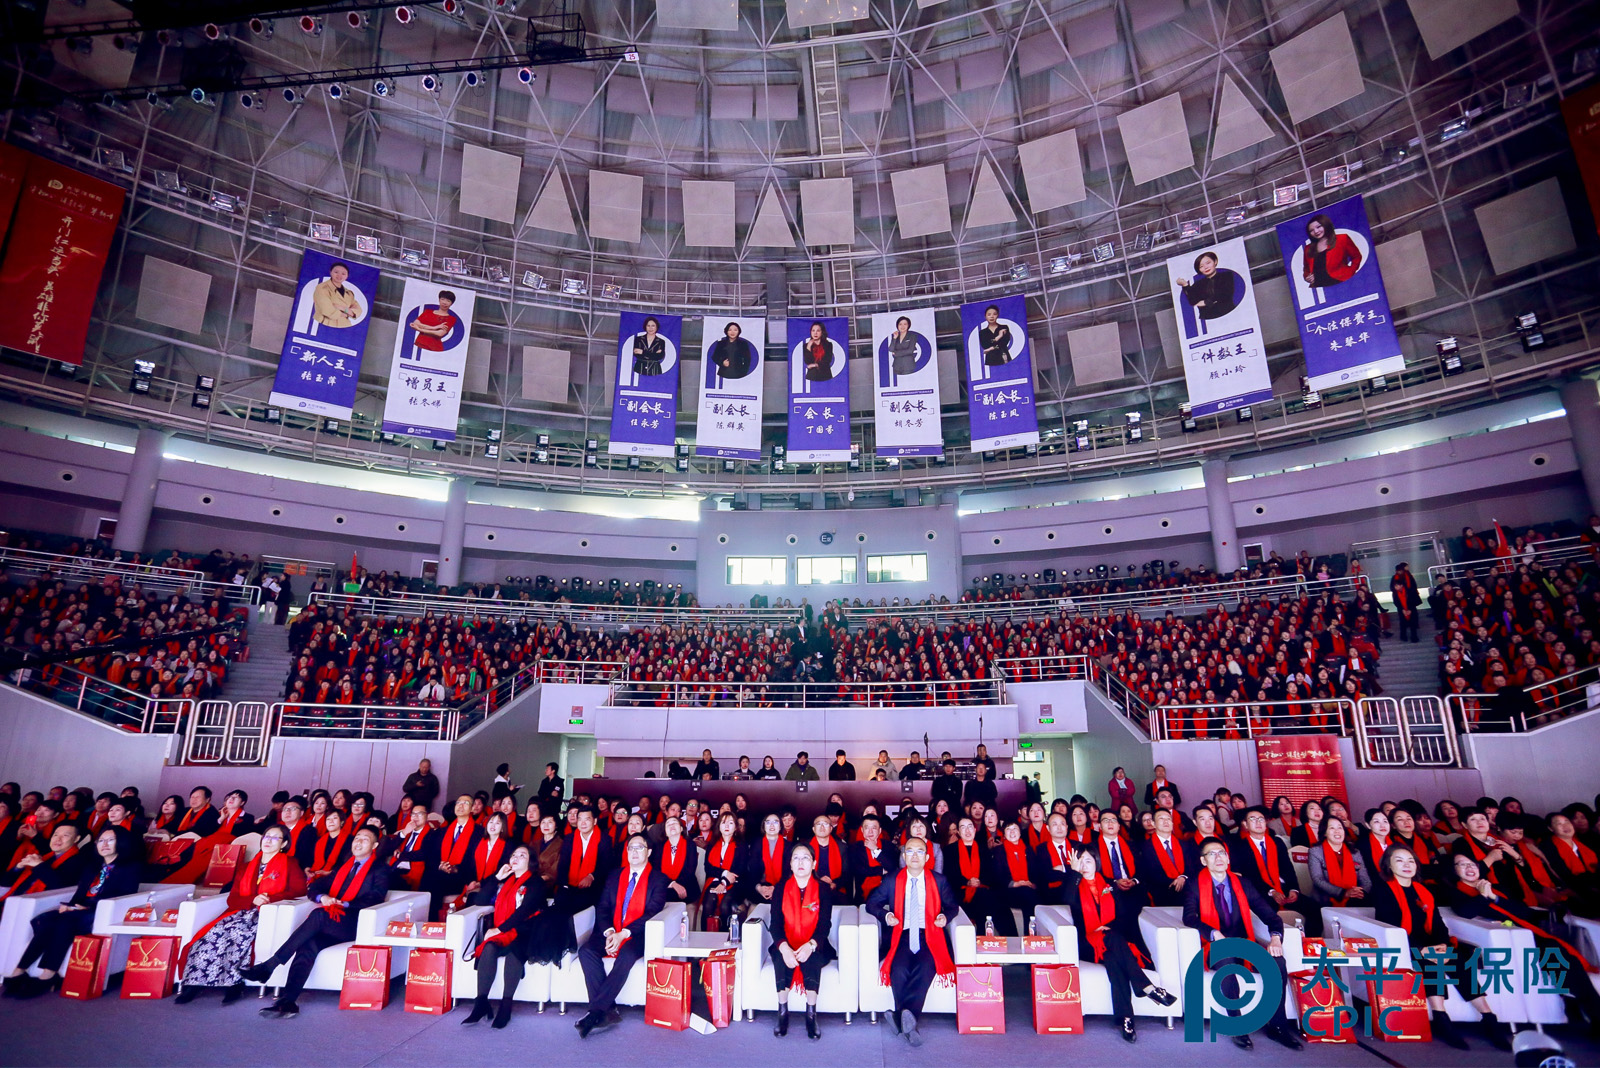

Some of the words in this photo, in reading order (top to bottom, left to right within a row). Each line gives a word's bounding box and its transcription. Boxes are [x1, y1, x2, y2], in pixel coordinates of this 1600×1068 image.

[299, 349, 345, 371] 新人王
[1200, 342, 1247, 365] 件数王
[405, 376, 447, 393] 增员王
[982, 389, 1022, 406] 副会长
[626, 399, 665, 415] 副会长
[712, 402, 750, 417] 副会长
[803, 405, 835, 420] 会长
[889, 399, 928, 414] 副会长
[988, 407, 1020, 421] 陈玉凤
[894, 418, 924, 428] 胡冬芳
